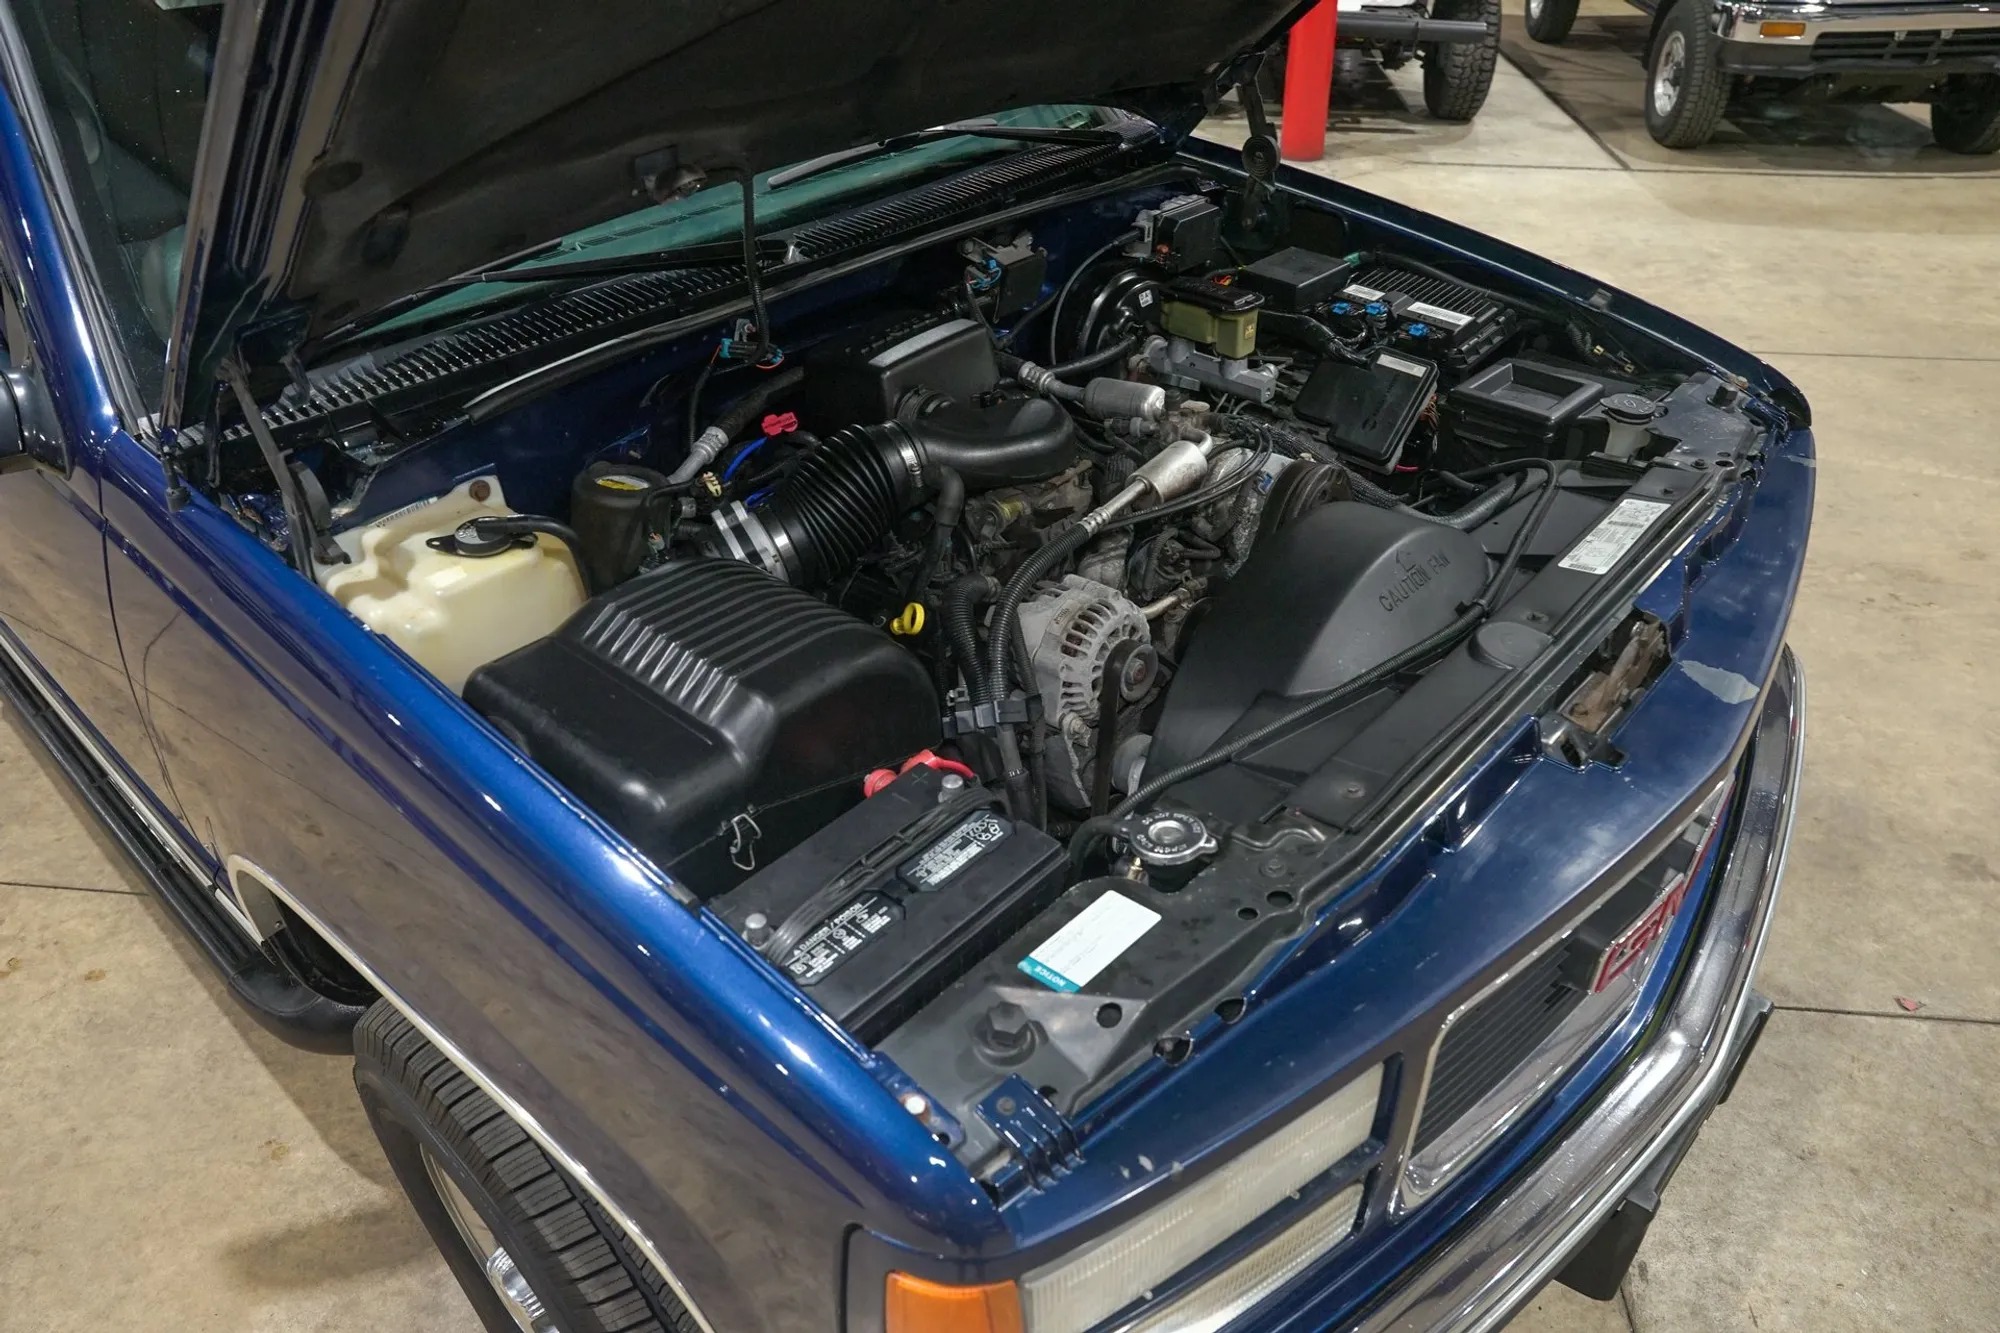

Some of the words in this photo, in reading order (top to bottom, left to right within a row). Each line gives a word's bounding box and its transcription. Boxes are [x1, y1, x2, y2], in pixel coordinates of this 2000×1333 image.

[1379, 563, 1432, 612] CAUTION
[1427, 550, 1451, 575] FAN
[799, 926, 831, 950] DANGER
[834, 903, 863, 925] POISON
[1035, 965, 1066, 987] NOTICE
